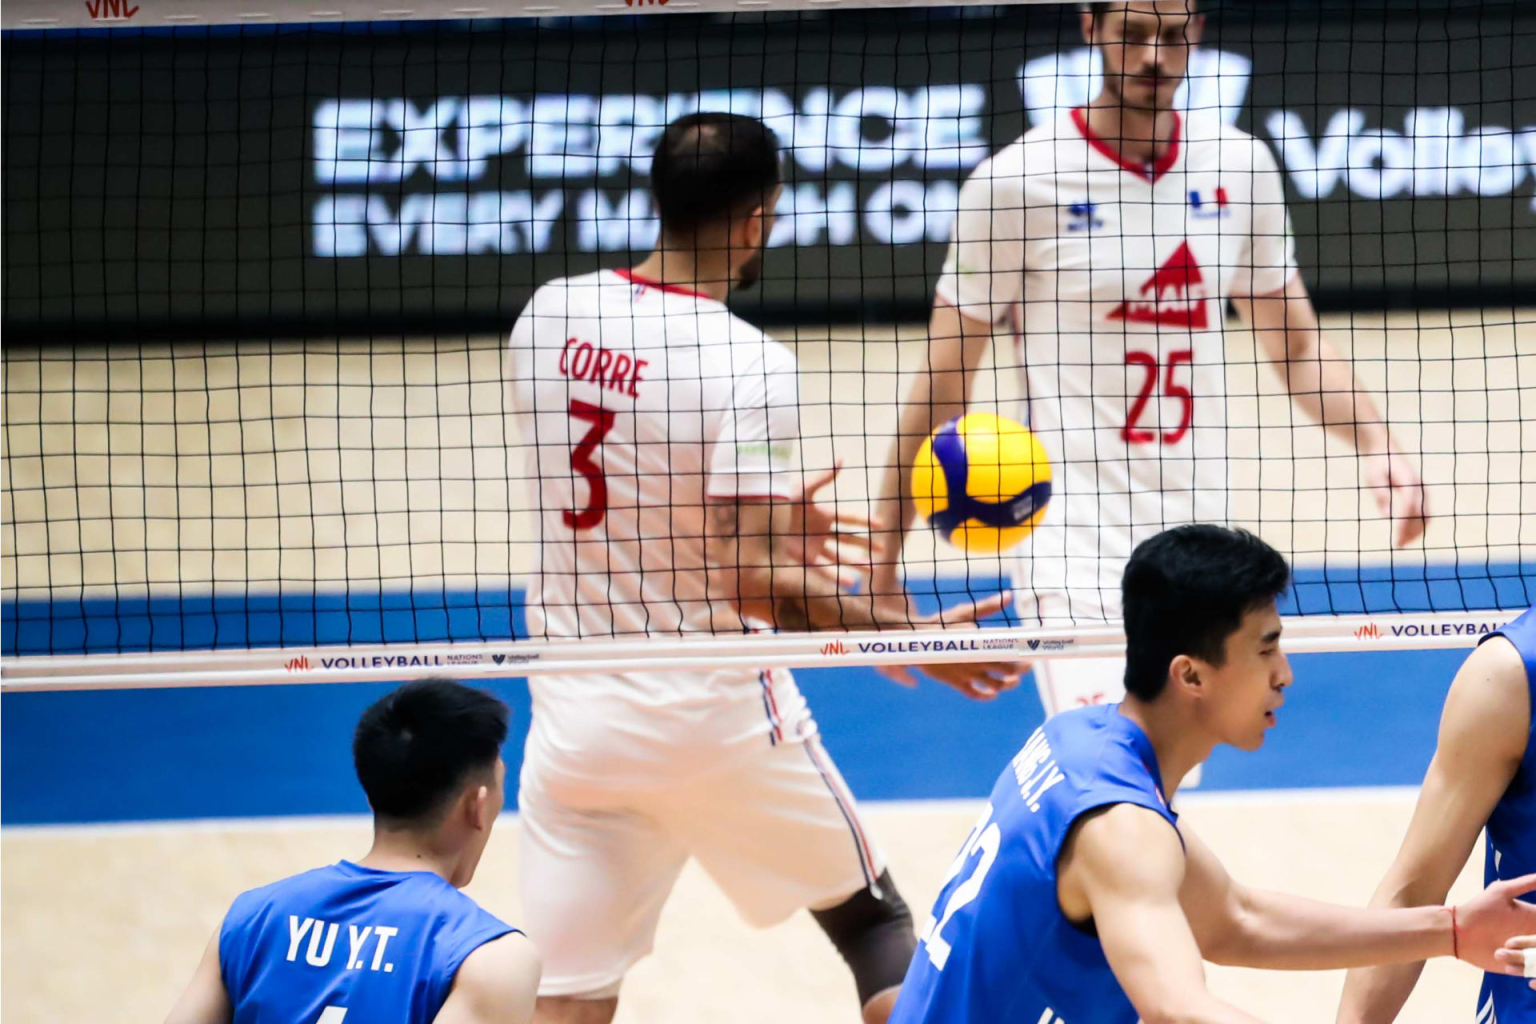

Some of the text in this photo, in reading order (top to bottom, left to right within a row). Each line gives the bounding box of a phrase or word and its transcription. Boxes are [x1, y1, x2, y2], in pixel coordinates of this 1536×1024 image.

[311, 83, 986, 183] EXPERNCE
[559, 337, 649, 399] CORRE
[1120, 350, 1194, 446] 25
[562, 397, 616, 530] 3
[820, 639, 980, 657] VNL VOLLEYBALL
[1391, 622, 1508, 637] VOLLEYBAL
[284, 655, 445, 673] VNL VOLLEYBALL
[286, 914, 399, 973] YU Y.T.
